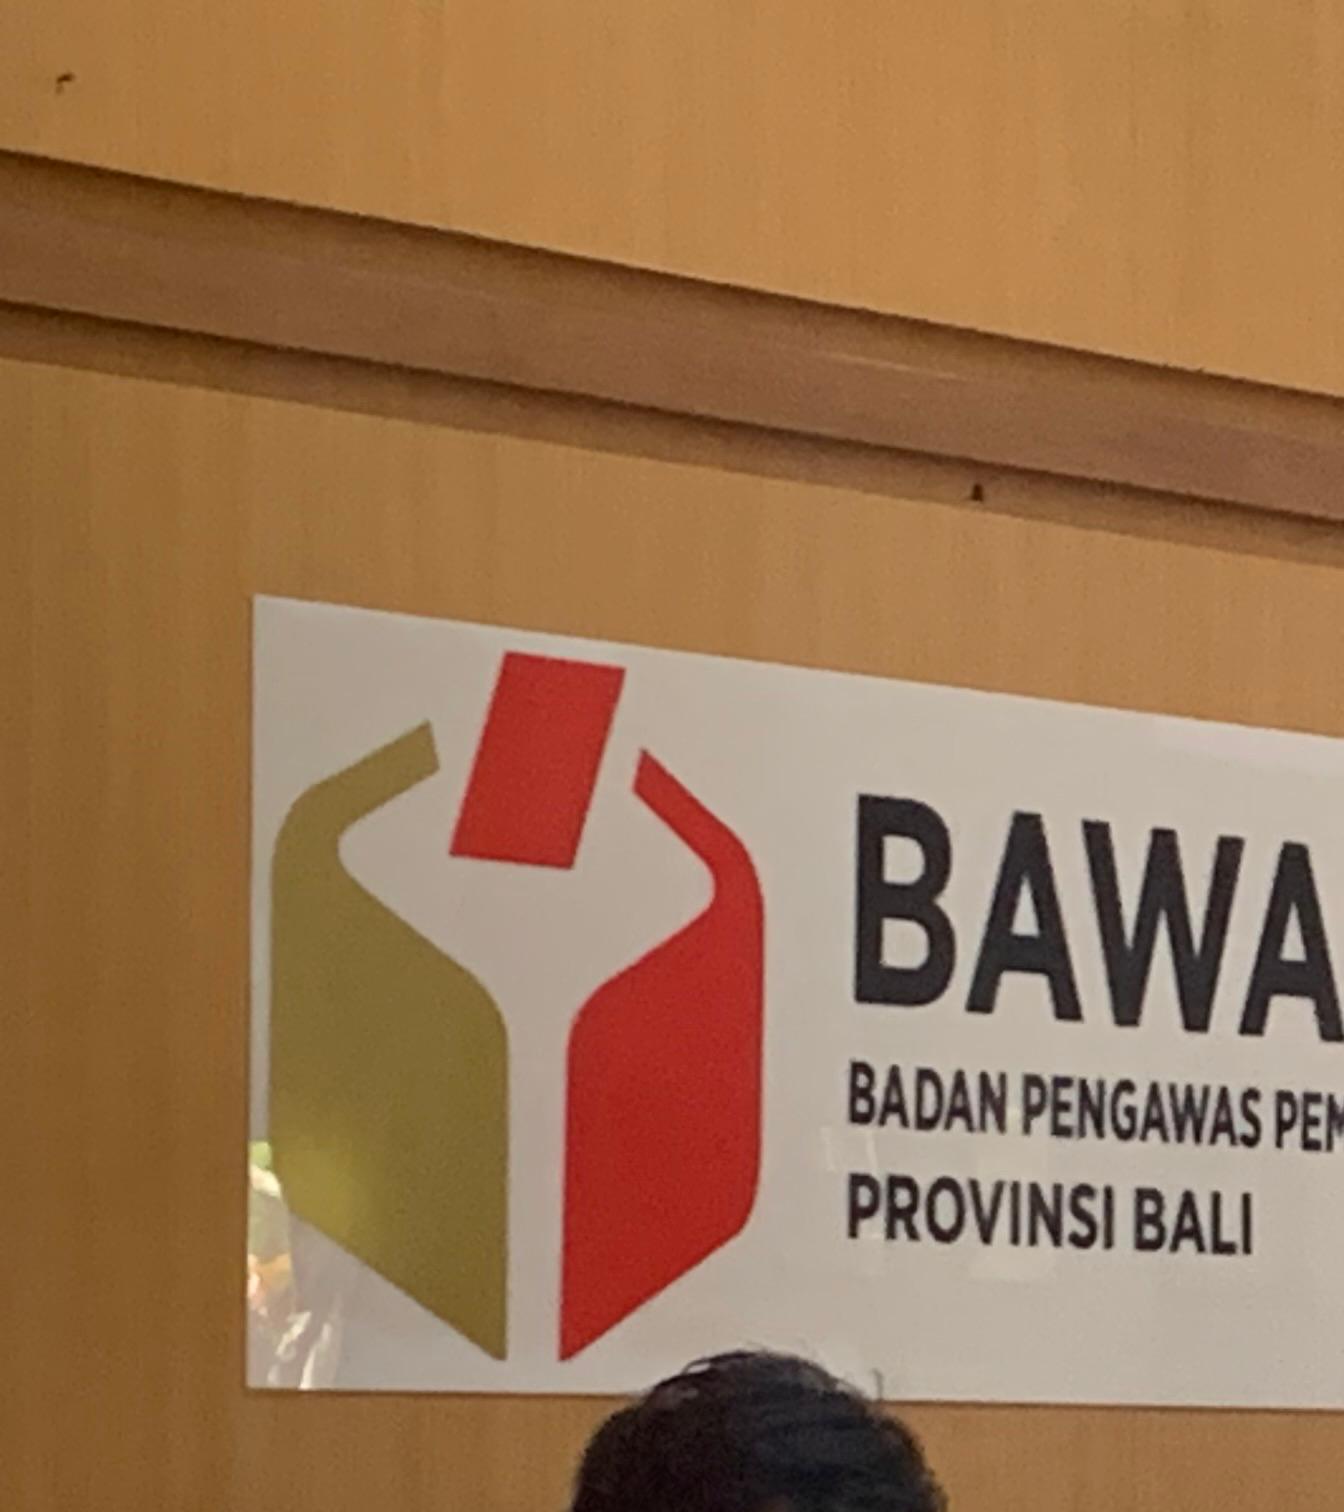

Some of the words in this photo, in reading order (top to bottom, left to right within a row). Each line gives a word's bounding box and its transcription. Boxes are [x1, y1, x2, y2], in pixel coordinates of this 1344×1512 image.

[848, 1061, 1007, 1135] BADAN
[1022, 1074, 1262, 1149] PENGAWAS
[847, 1172, 1114, 1250] PROVINSI
[1133, 1187, 1253, 1256] BALI
